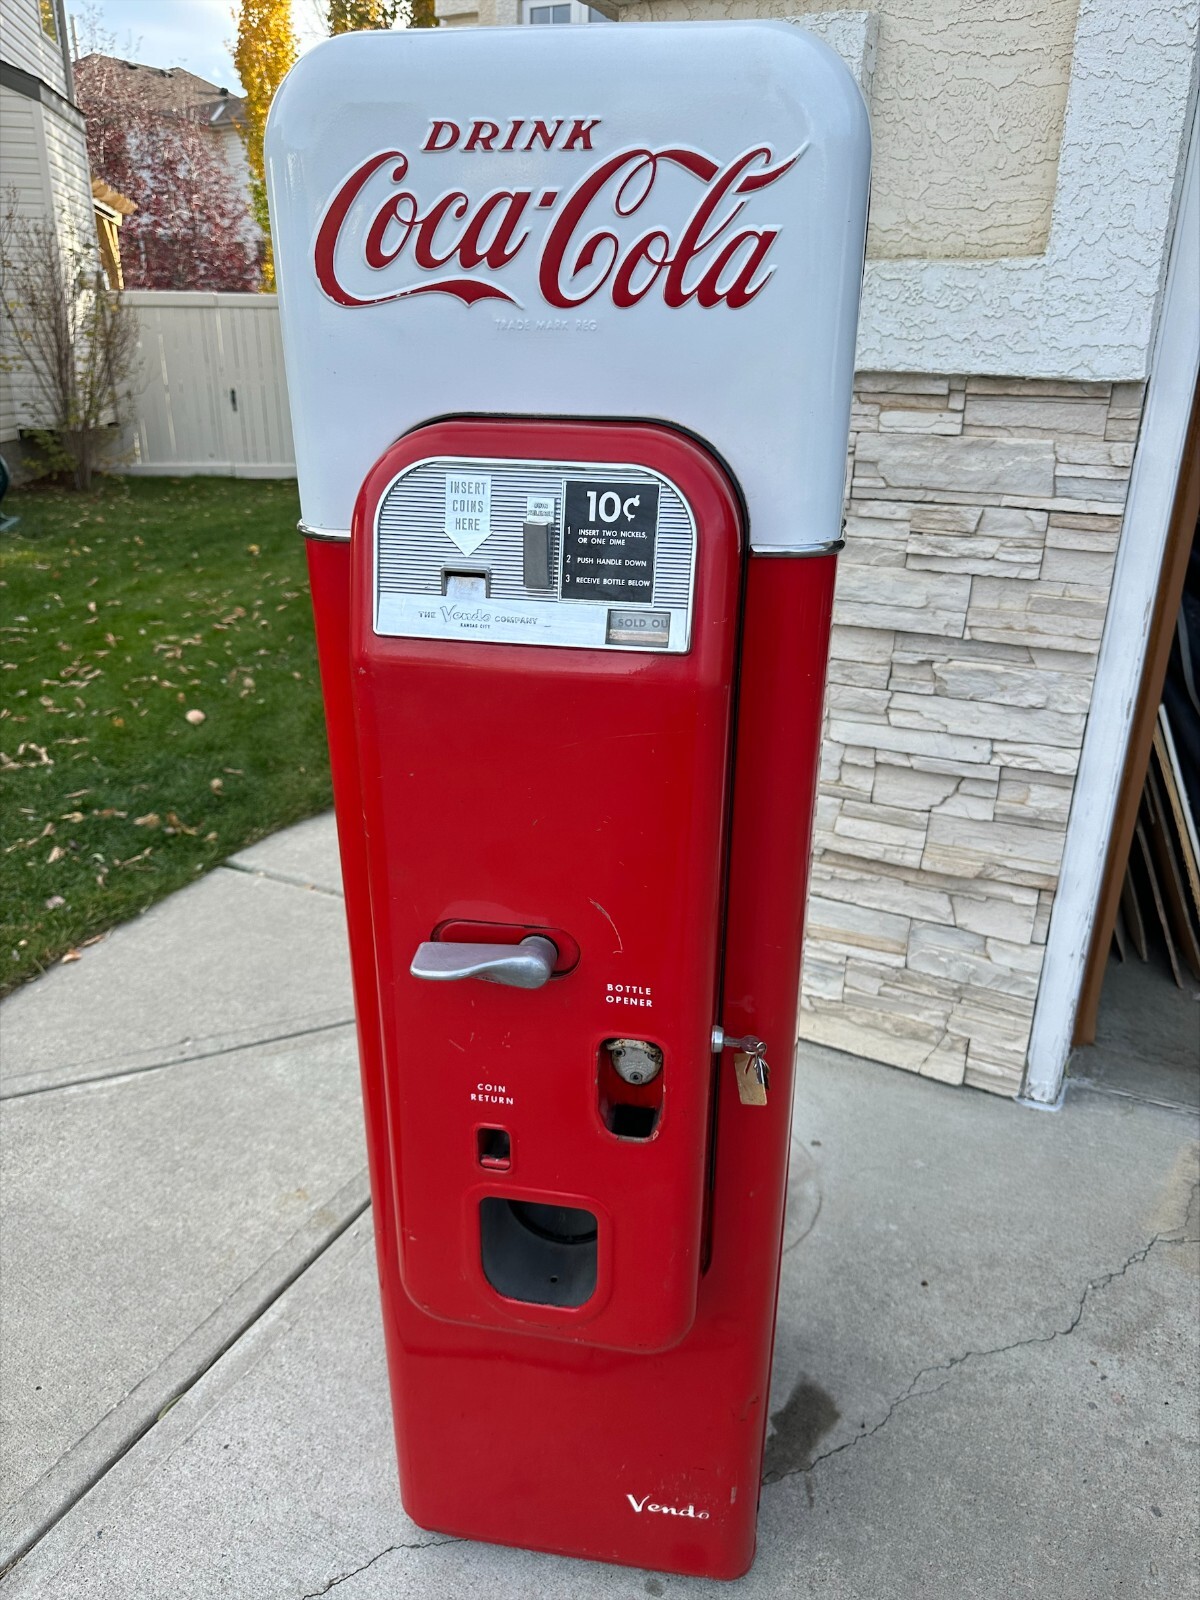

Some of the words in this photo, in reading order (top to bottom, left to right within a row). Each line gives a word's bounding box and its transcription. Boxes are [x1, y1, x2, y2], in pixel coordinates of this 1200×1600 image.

[423, 117, 602, 152] DRINK
[313, 142, 810, 310] Coca-Cola
[495, 318, 530, 331] TRADE
[536, 319, 568, 331] MARK
[575, 319, 598, 332] REG
[450, 481, 487, 495] INSERT
[452, 499, 484, 513] COINS
[586, 491, 641, 523] 10¢
[455, 517, 481, 531] HERE
[567, 526, 571, 535] 1
[620, 531, 648, 540] NICKELS,
[609, 538, 626, 546] DIME
[566, 554, 572, 564] 2
[596, 558, 622, 566] HANDLE
[624, 559, 647, 567] DOWN
[565, 574, 571, 583] 3
[576, 577, 600, 585] RECEIVE
[602, 578, 625, 586] BOTTLE
[627, 579, 651, 587] BELOW
[418, 611, 436, 619] THE
[440, 604, 491, 623] Vendo
[494, 615, 538, 625] COMPANY
[618, 618, 646, 628] SOLD
[606, 983, 652, 995] BOTTLE
[605, 995, 653, 1008] OPENER
[477, 1083, 506, 1094] COIN
[470, 1093, 514, 1106] RETURN
[626, 1494, 710, 1520] Vendo
